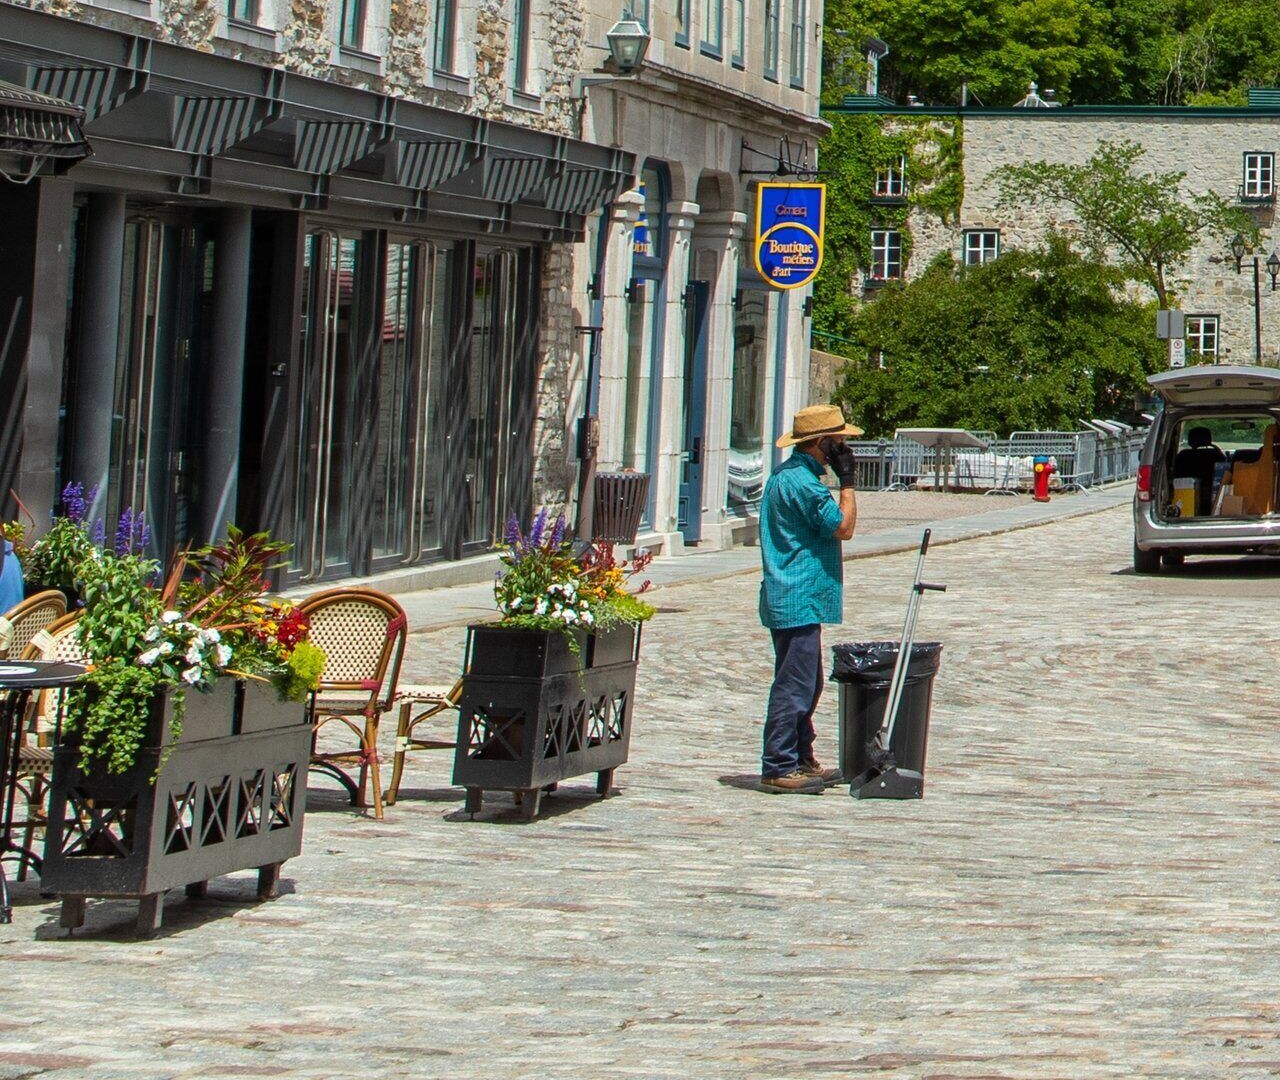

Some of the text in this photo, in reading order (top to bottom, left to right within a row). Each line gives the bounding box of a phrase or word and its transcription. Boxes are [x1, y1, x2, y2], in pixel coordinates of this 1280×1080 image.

[769, 239, 814, 255] Boutique
[782, 252, 814, 265] métiers
[771, 266, 792, 276] d'art
